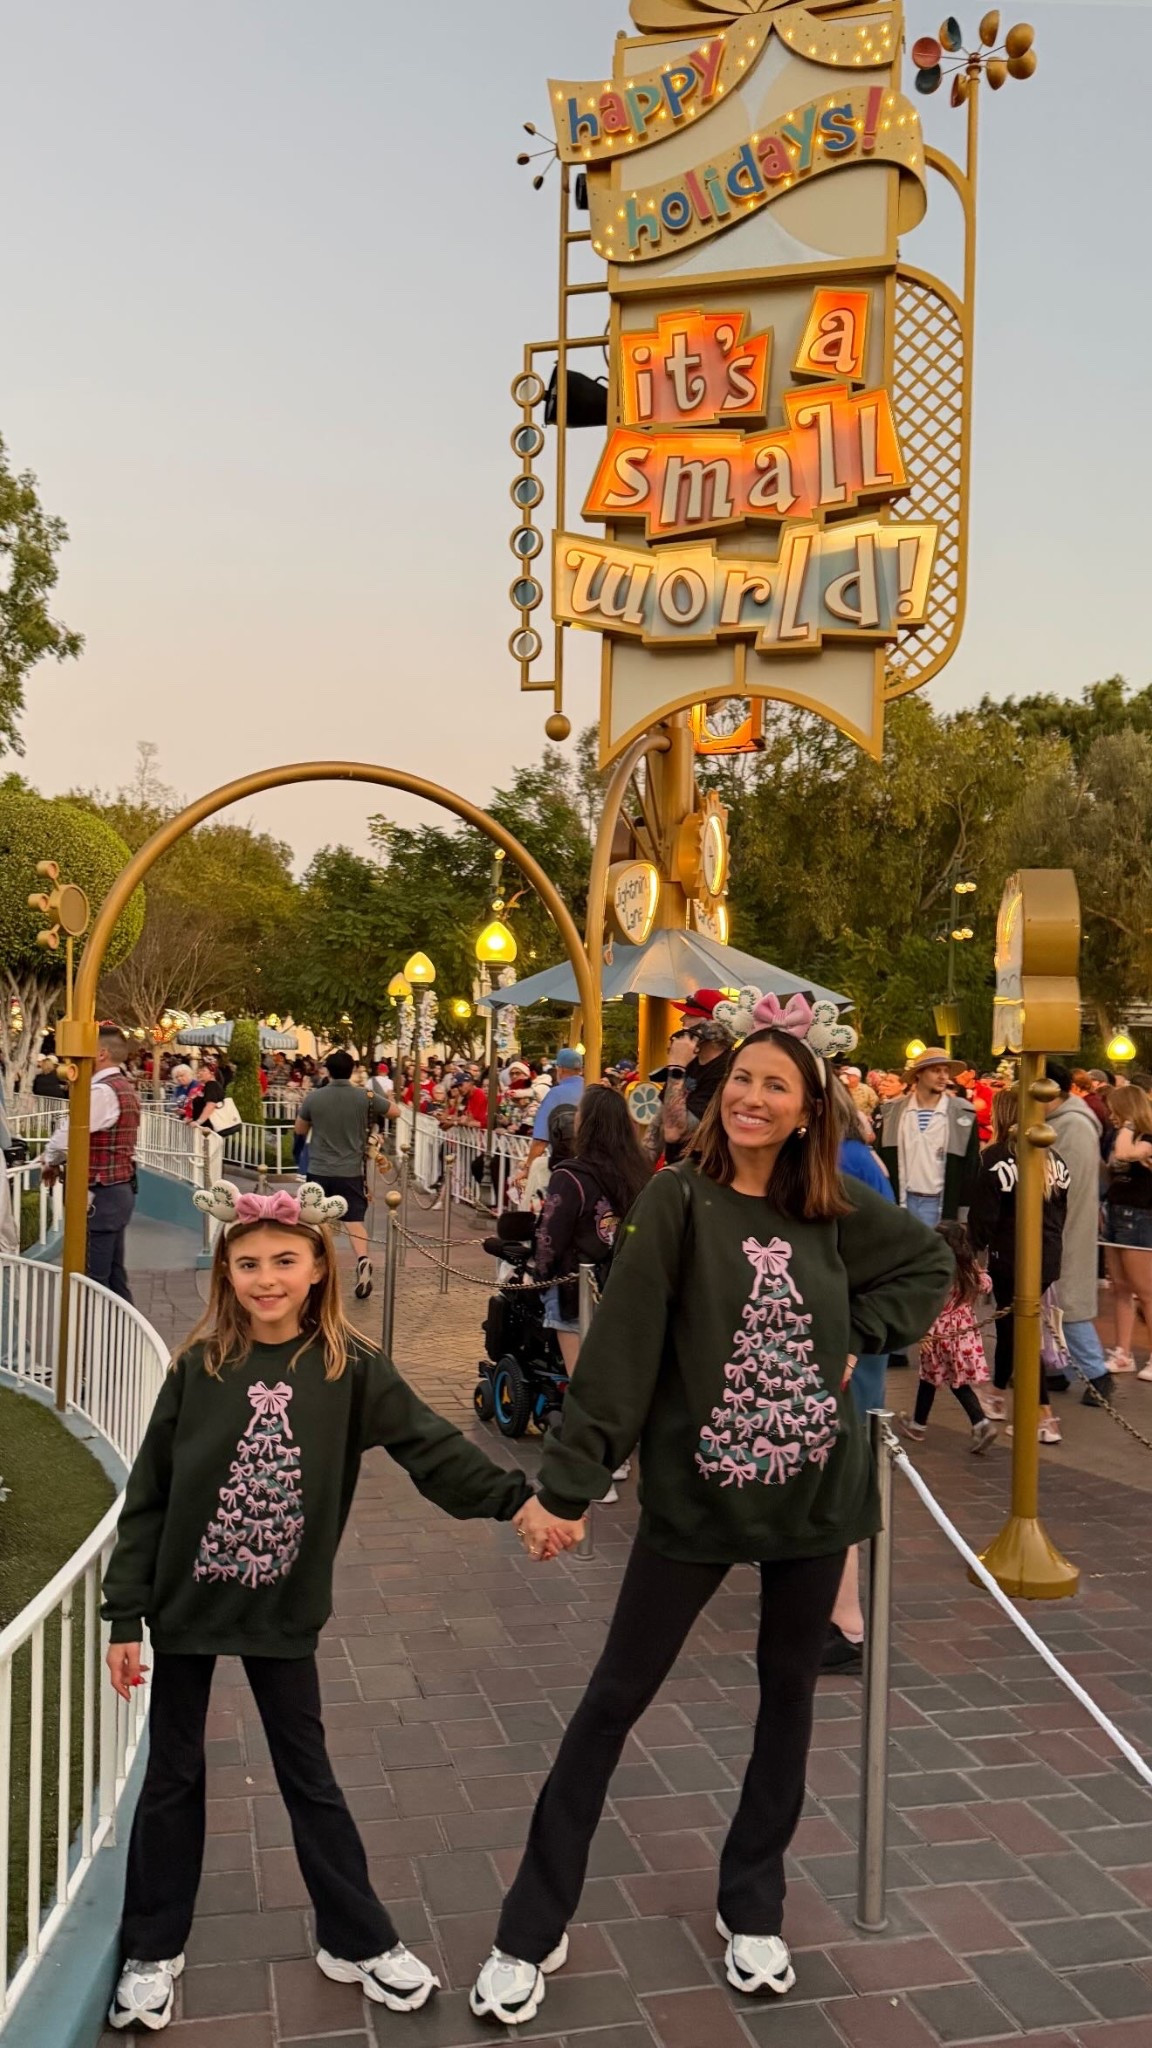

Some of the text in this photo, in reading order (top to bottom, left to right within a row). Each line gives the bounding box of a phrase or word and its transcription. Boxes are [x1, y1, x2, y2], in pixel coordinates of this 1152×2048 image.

[567, 38, 727, 147] happy
[624, 86, 886, 252] holidays!
[807, 307, 860, 373] a
[600, 402, 893, 526] small
[564, 534, 922, 641] world!
